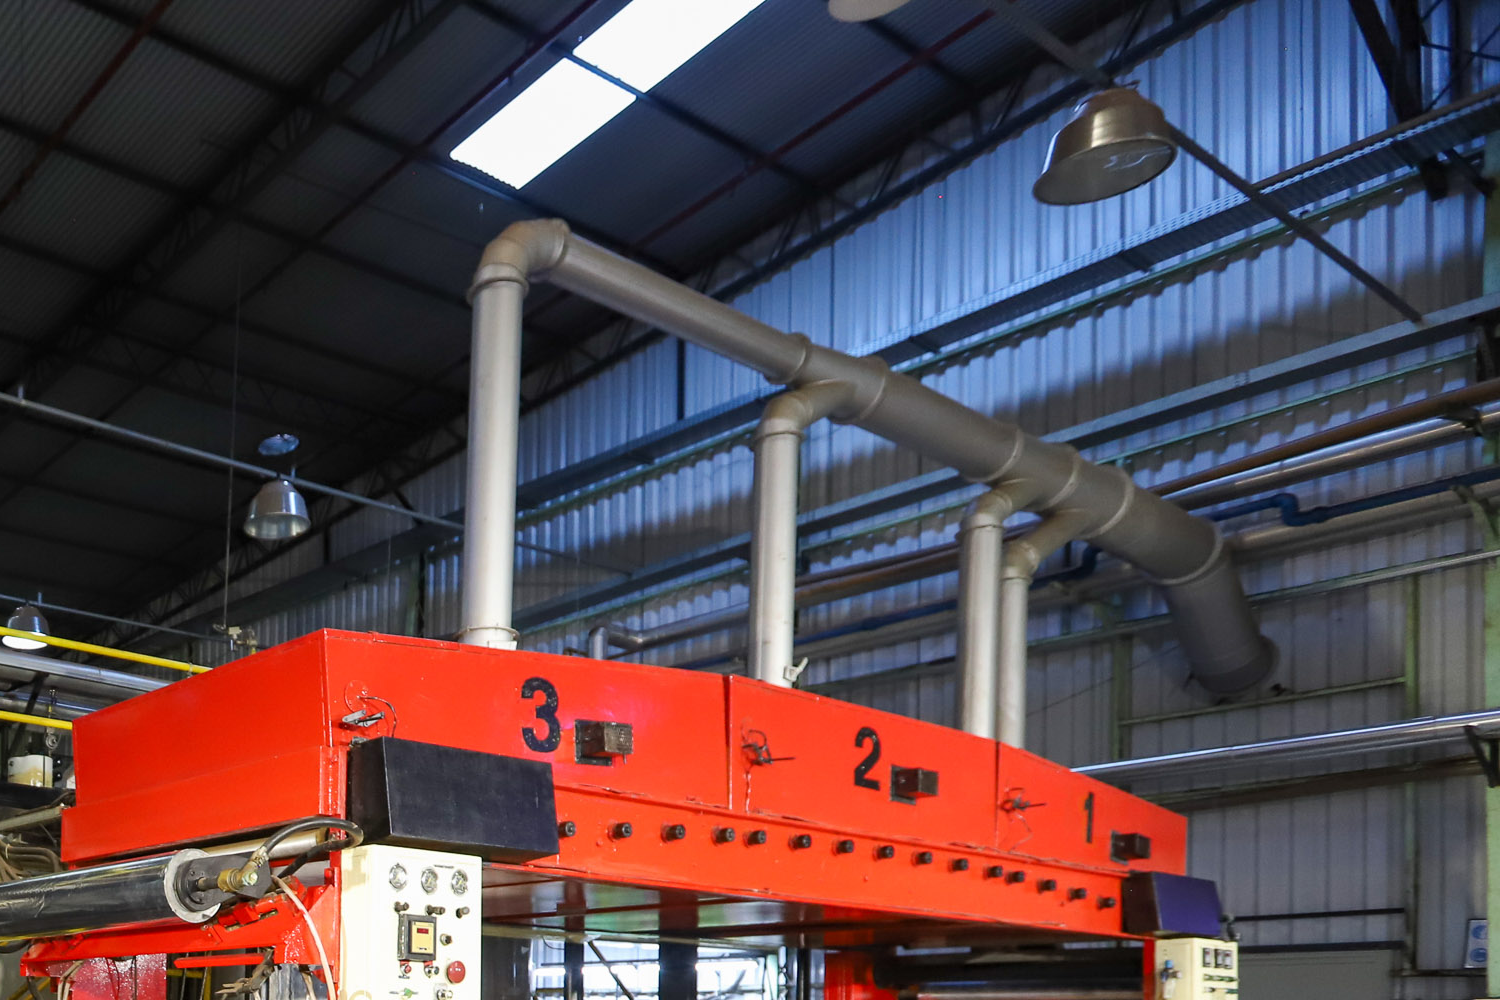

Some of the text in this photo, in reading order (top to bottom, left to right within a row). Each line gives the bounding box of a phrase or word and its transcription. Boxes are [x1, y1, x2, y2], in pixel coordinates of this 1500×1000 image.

[521, 677, 561, 753] 3
[853, 726, 881, 791] 2
[1084, 791, 1095, 843] 1
